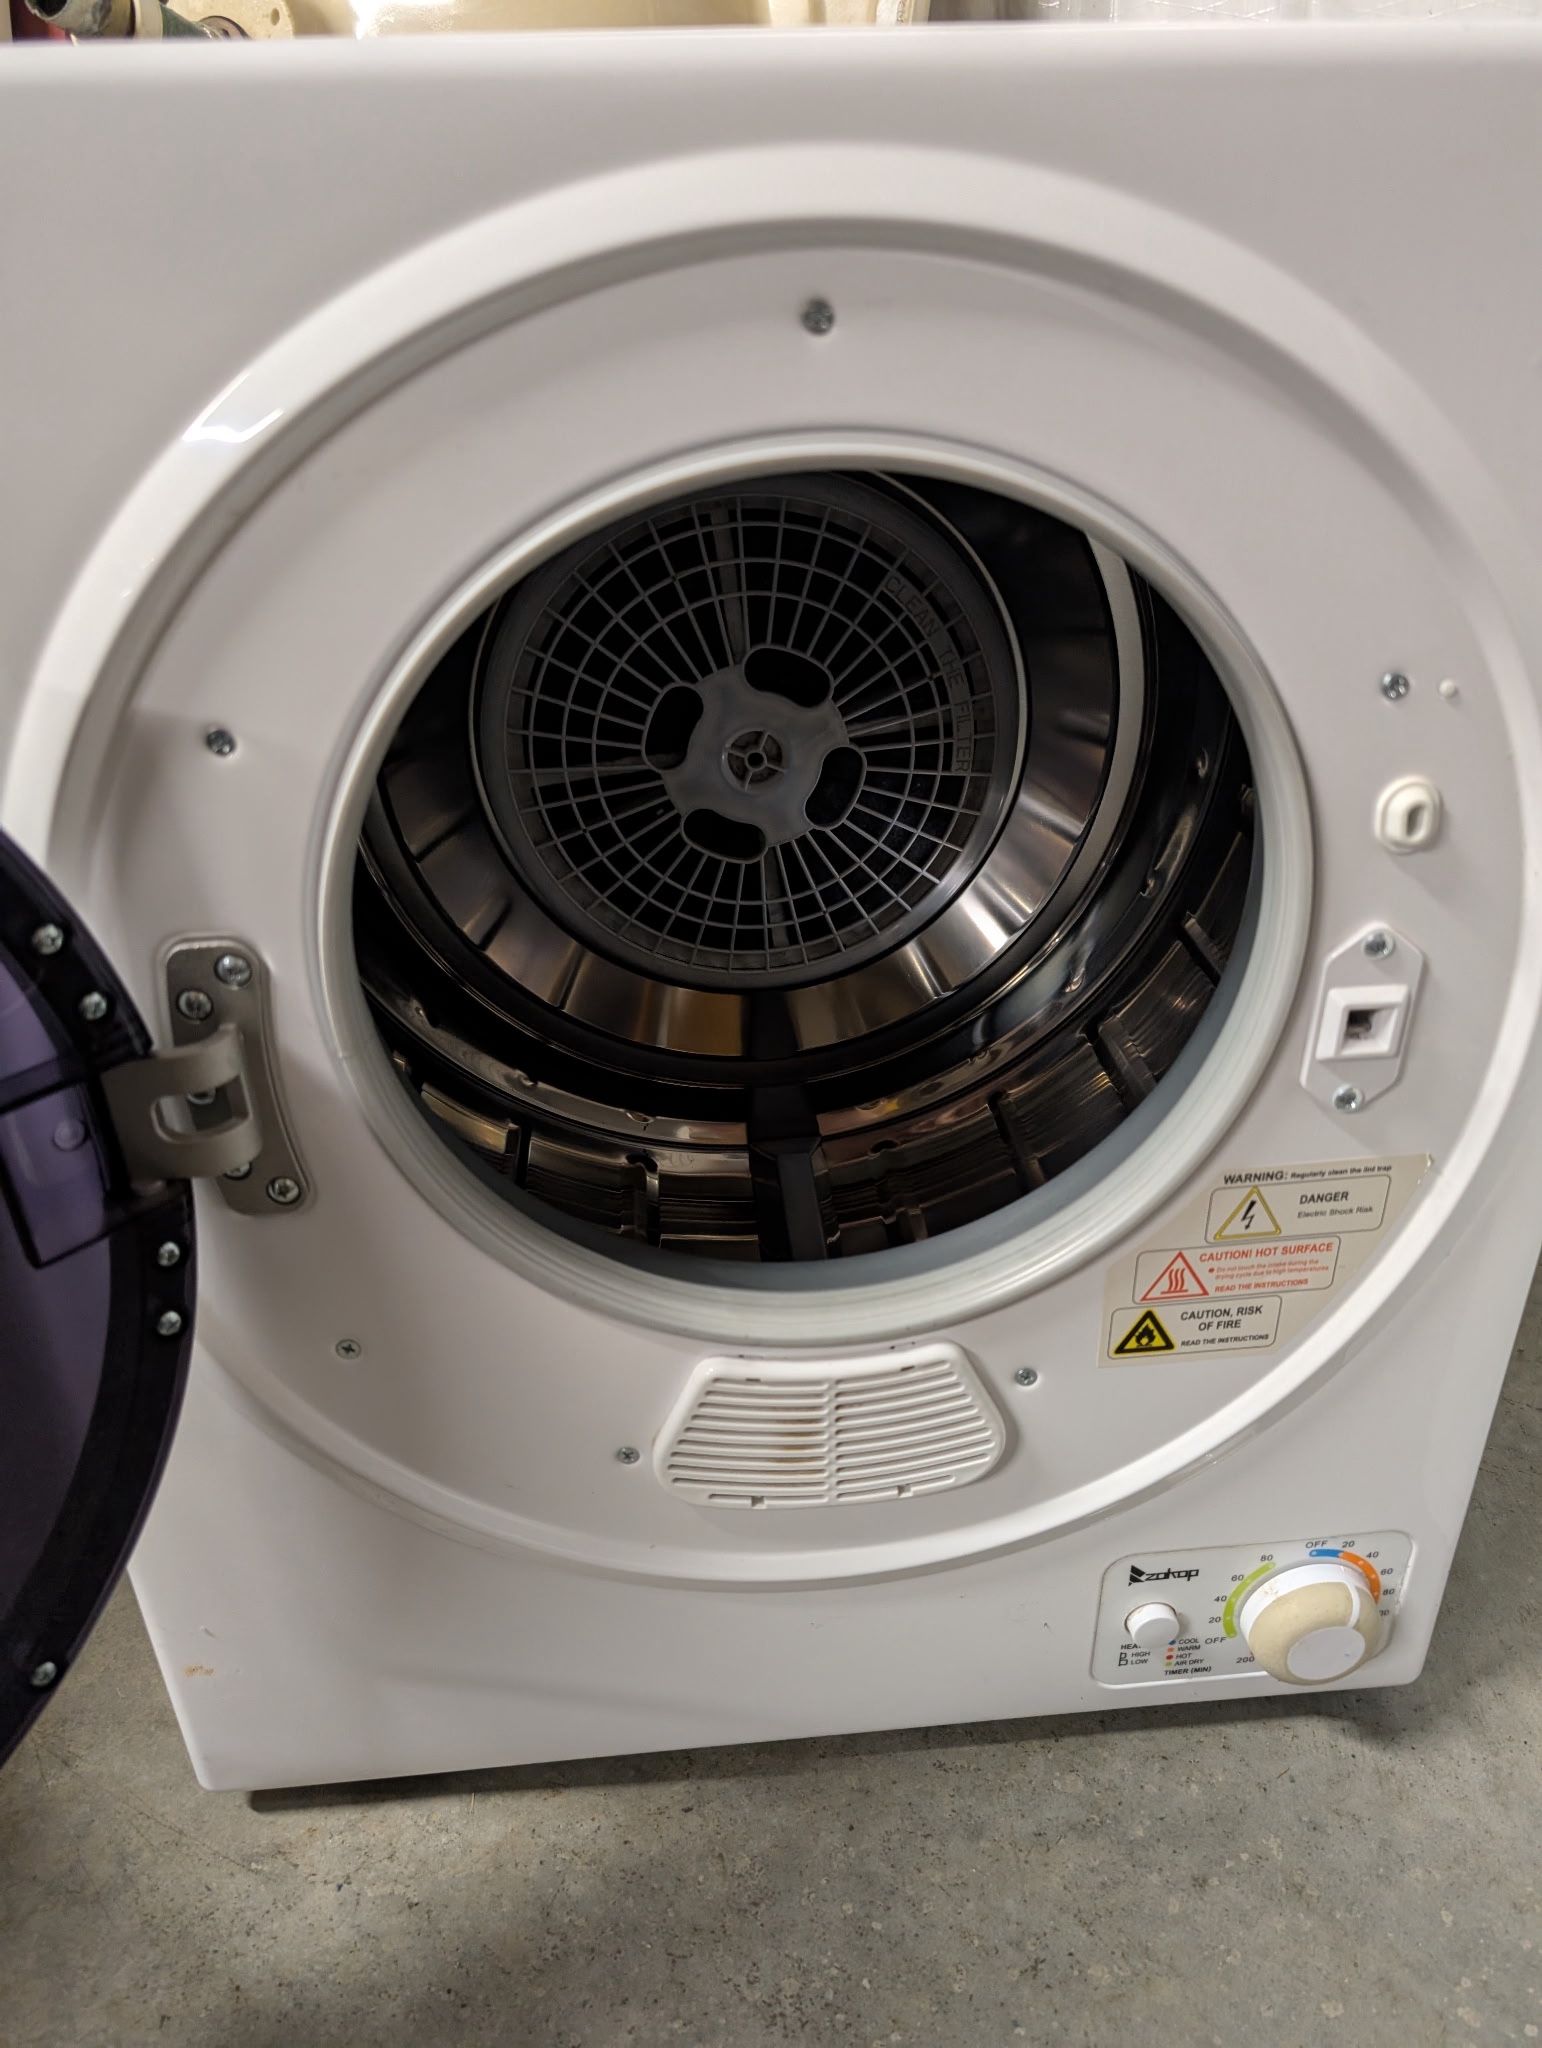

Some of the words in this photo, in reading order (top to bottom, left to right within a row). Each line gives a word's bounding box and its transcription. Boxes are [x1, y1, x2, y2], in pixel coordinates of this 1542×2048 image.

[884, 577, 941, 639] CLEAN
[939, 650, 965, 689] THE
[954, 705, 972, 774] FILTER
[1223, 1170, 1289, 1185] WARNING:
[1299, 1191, 1349, 1205] DANGER
[1297, 1209, 1327, 1219] Electric
[1329, 1207, 1354, 1217] Shock
[1355, 1205, 1373, 1214] Risk
[1199, 1250, 1253, 1263] CAUTION!
[1255, 1246, 1278, 1257] HOT
[1281, 1242, 1334, 1255] SURFACE
[1214, 1284, 1236, 1293] READ
[1253, 1278, 1309, 1289] INSTRUCTIONS
[1180, 1307, 1233, 1321] CAUTION,
[1236, 1305, 1263, 1316] RISK
[1198, 1322, 1214, 1332] OF
[1216, 1319, 1242, 1330] FIRE
[1180, 1338, 1201, 1347] READ
[1202, 1337, 1216, 1345] THE
[1217, 1333, 1269, 1343] INSTRUCTIONS
[1305, 1540, 1329, 1549] OFF
[1342, 1540, 1355, 1548] 20
[1260, 1554, 1273, 1562] 80
[1366, 1550, 1380, 1559] 40
[1380, 1567, 1394, 1576] 60
[1231, 1574, 1245, 1582] 60
[1382, 1588, 1395, 1596] 80
[1208, 1616, 1222, 1624] 20
[1178, 1637, 1200, 1645] COOL
[1204, 1636, 1227, 1645] OFF
[1177, 1644, 1201, 1652] WARM
[1175, 1652, 1192, 1660] HOT
[1236, 1655, 1255, 1664] 200
[1174, 1659, 1187, 1667] AIR
[1188, 1658, 1205, 1666] DRY
[1164, 1667, 1189, 1676] TIMER
[1190, 1666, 1212, 1674] (MIN)
